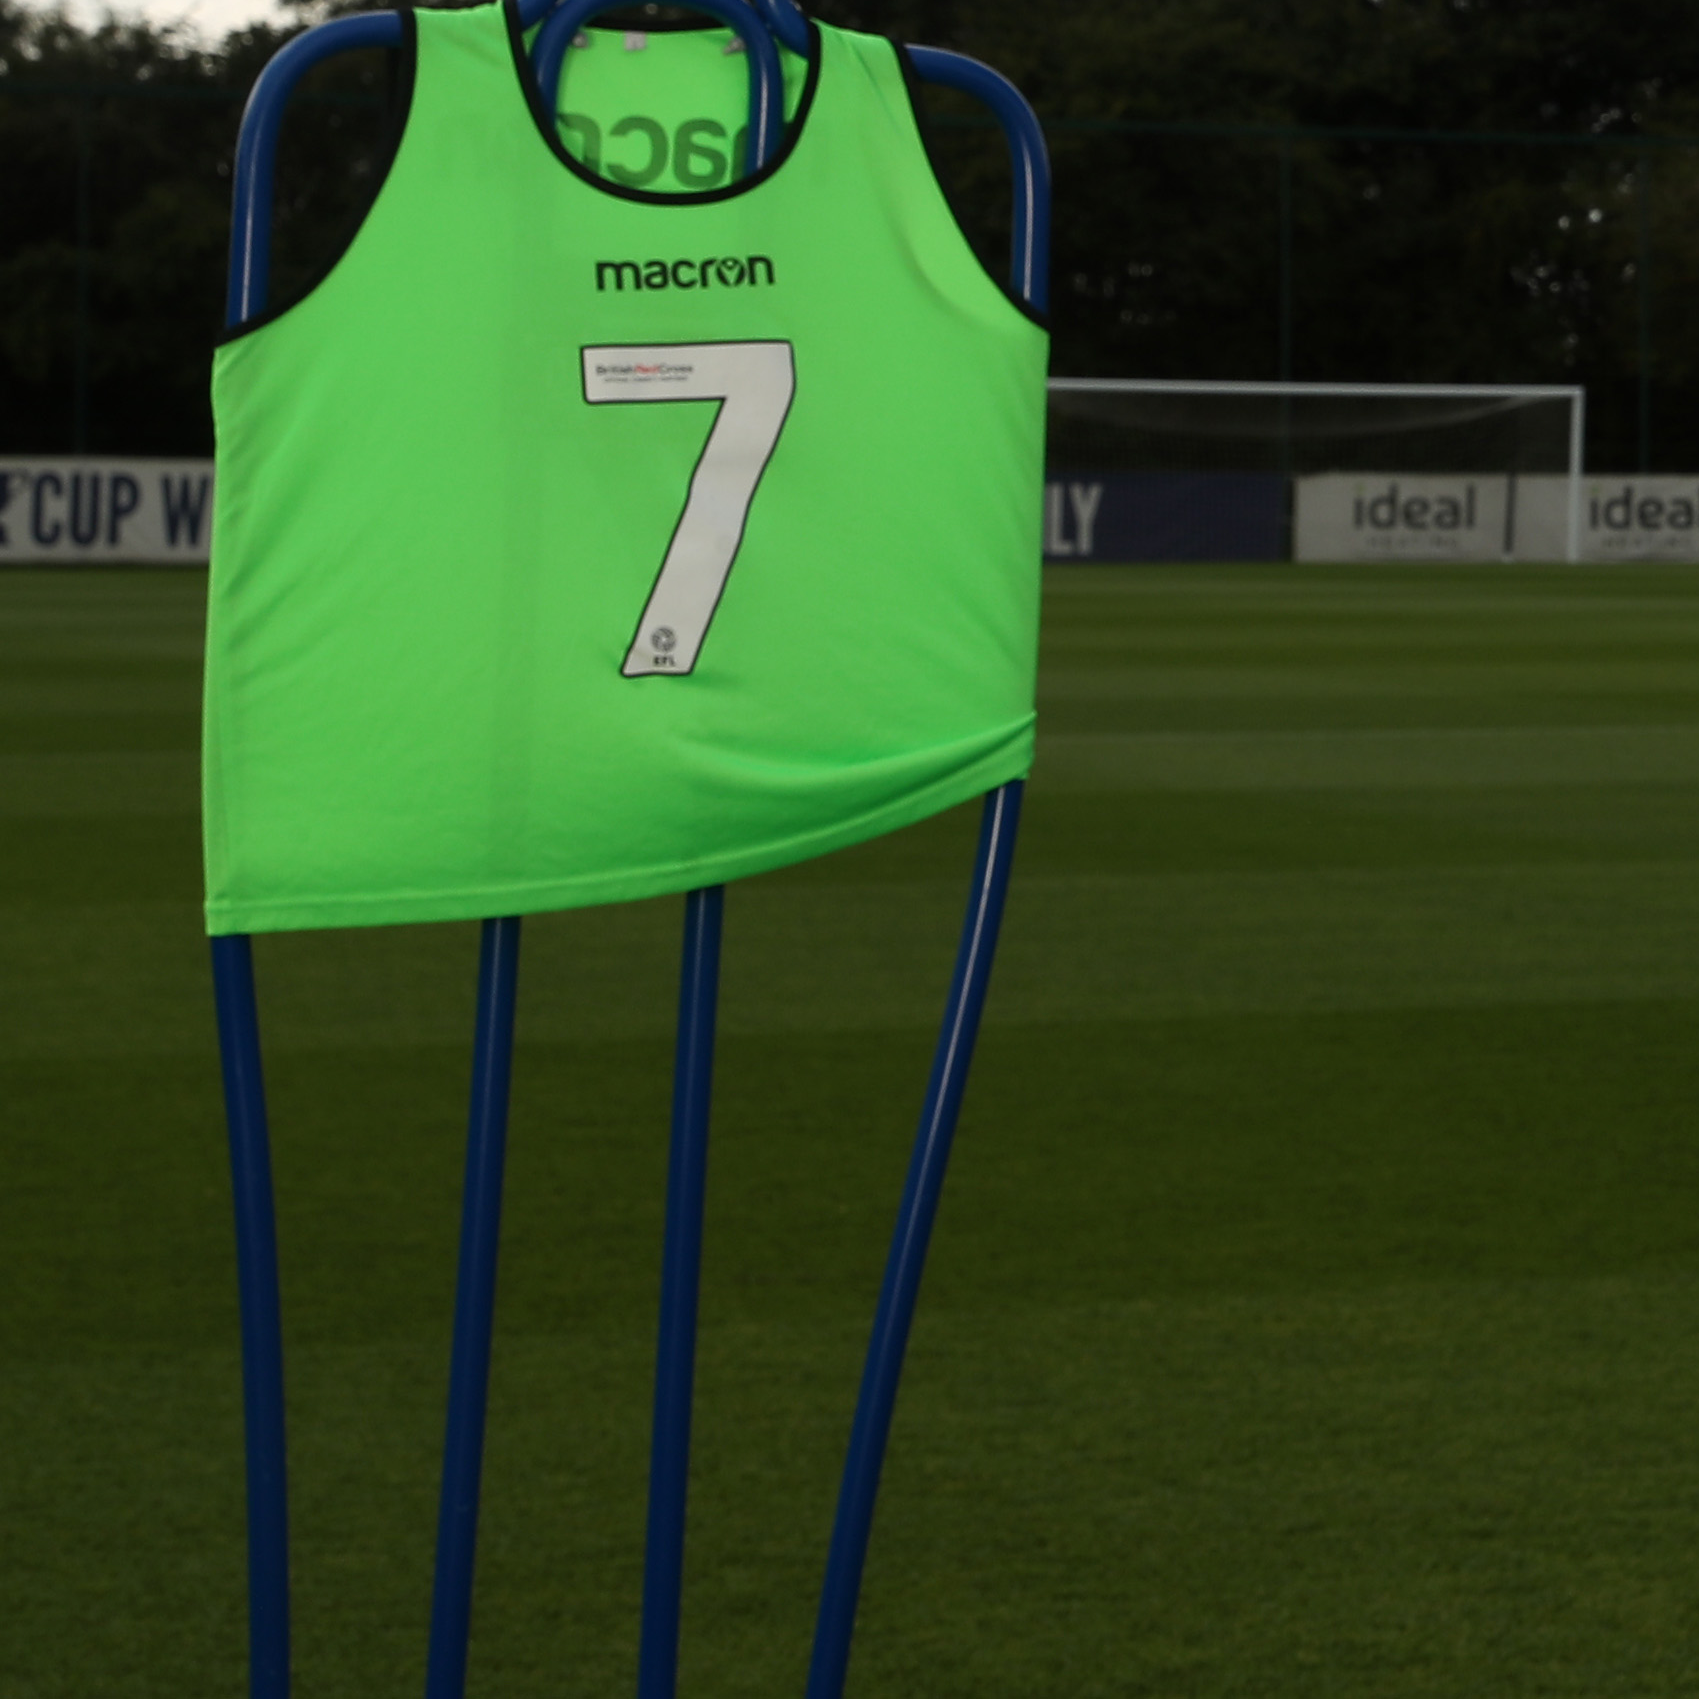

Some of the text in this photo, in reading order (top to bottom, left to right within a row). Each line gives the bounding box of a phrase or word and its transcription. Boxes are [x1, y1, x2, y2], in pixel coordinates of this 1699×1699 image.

[596, 255, 775, 291] macron
[32, 472, 140, 547] CUP
[580, 339, 795, 677] 7
[1353, 481, 1478, 530] ideal
